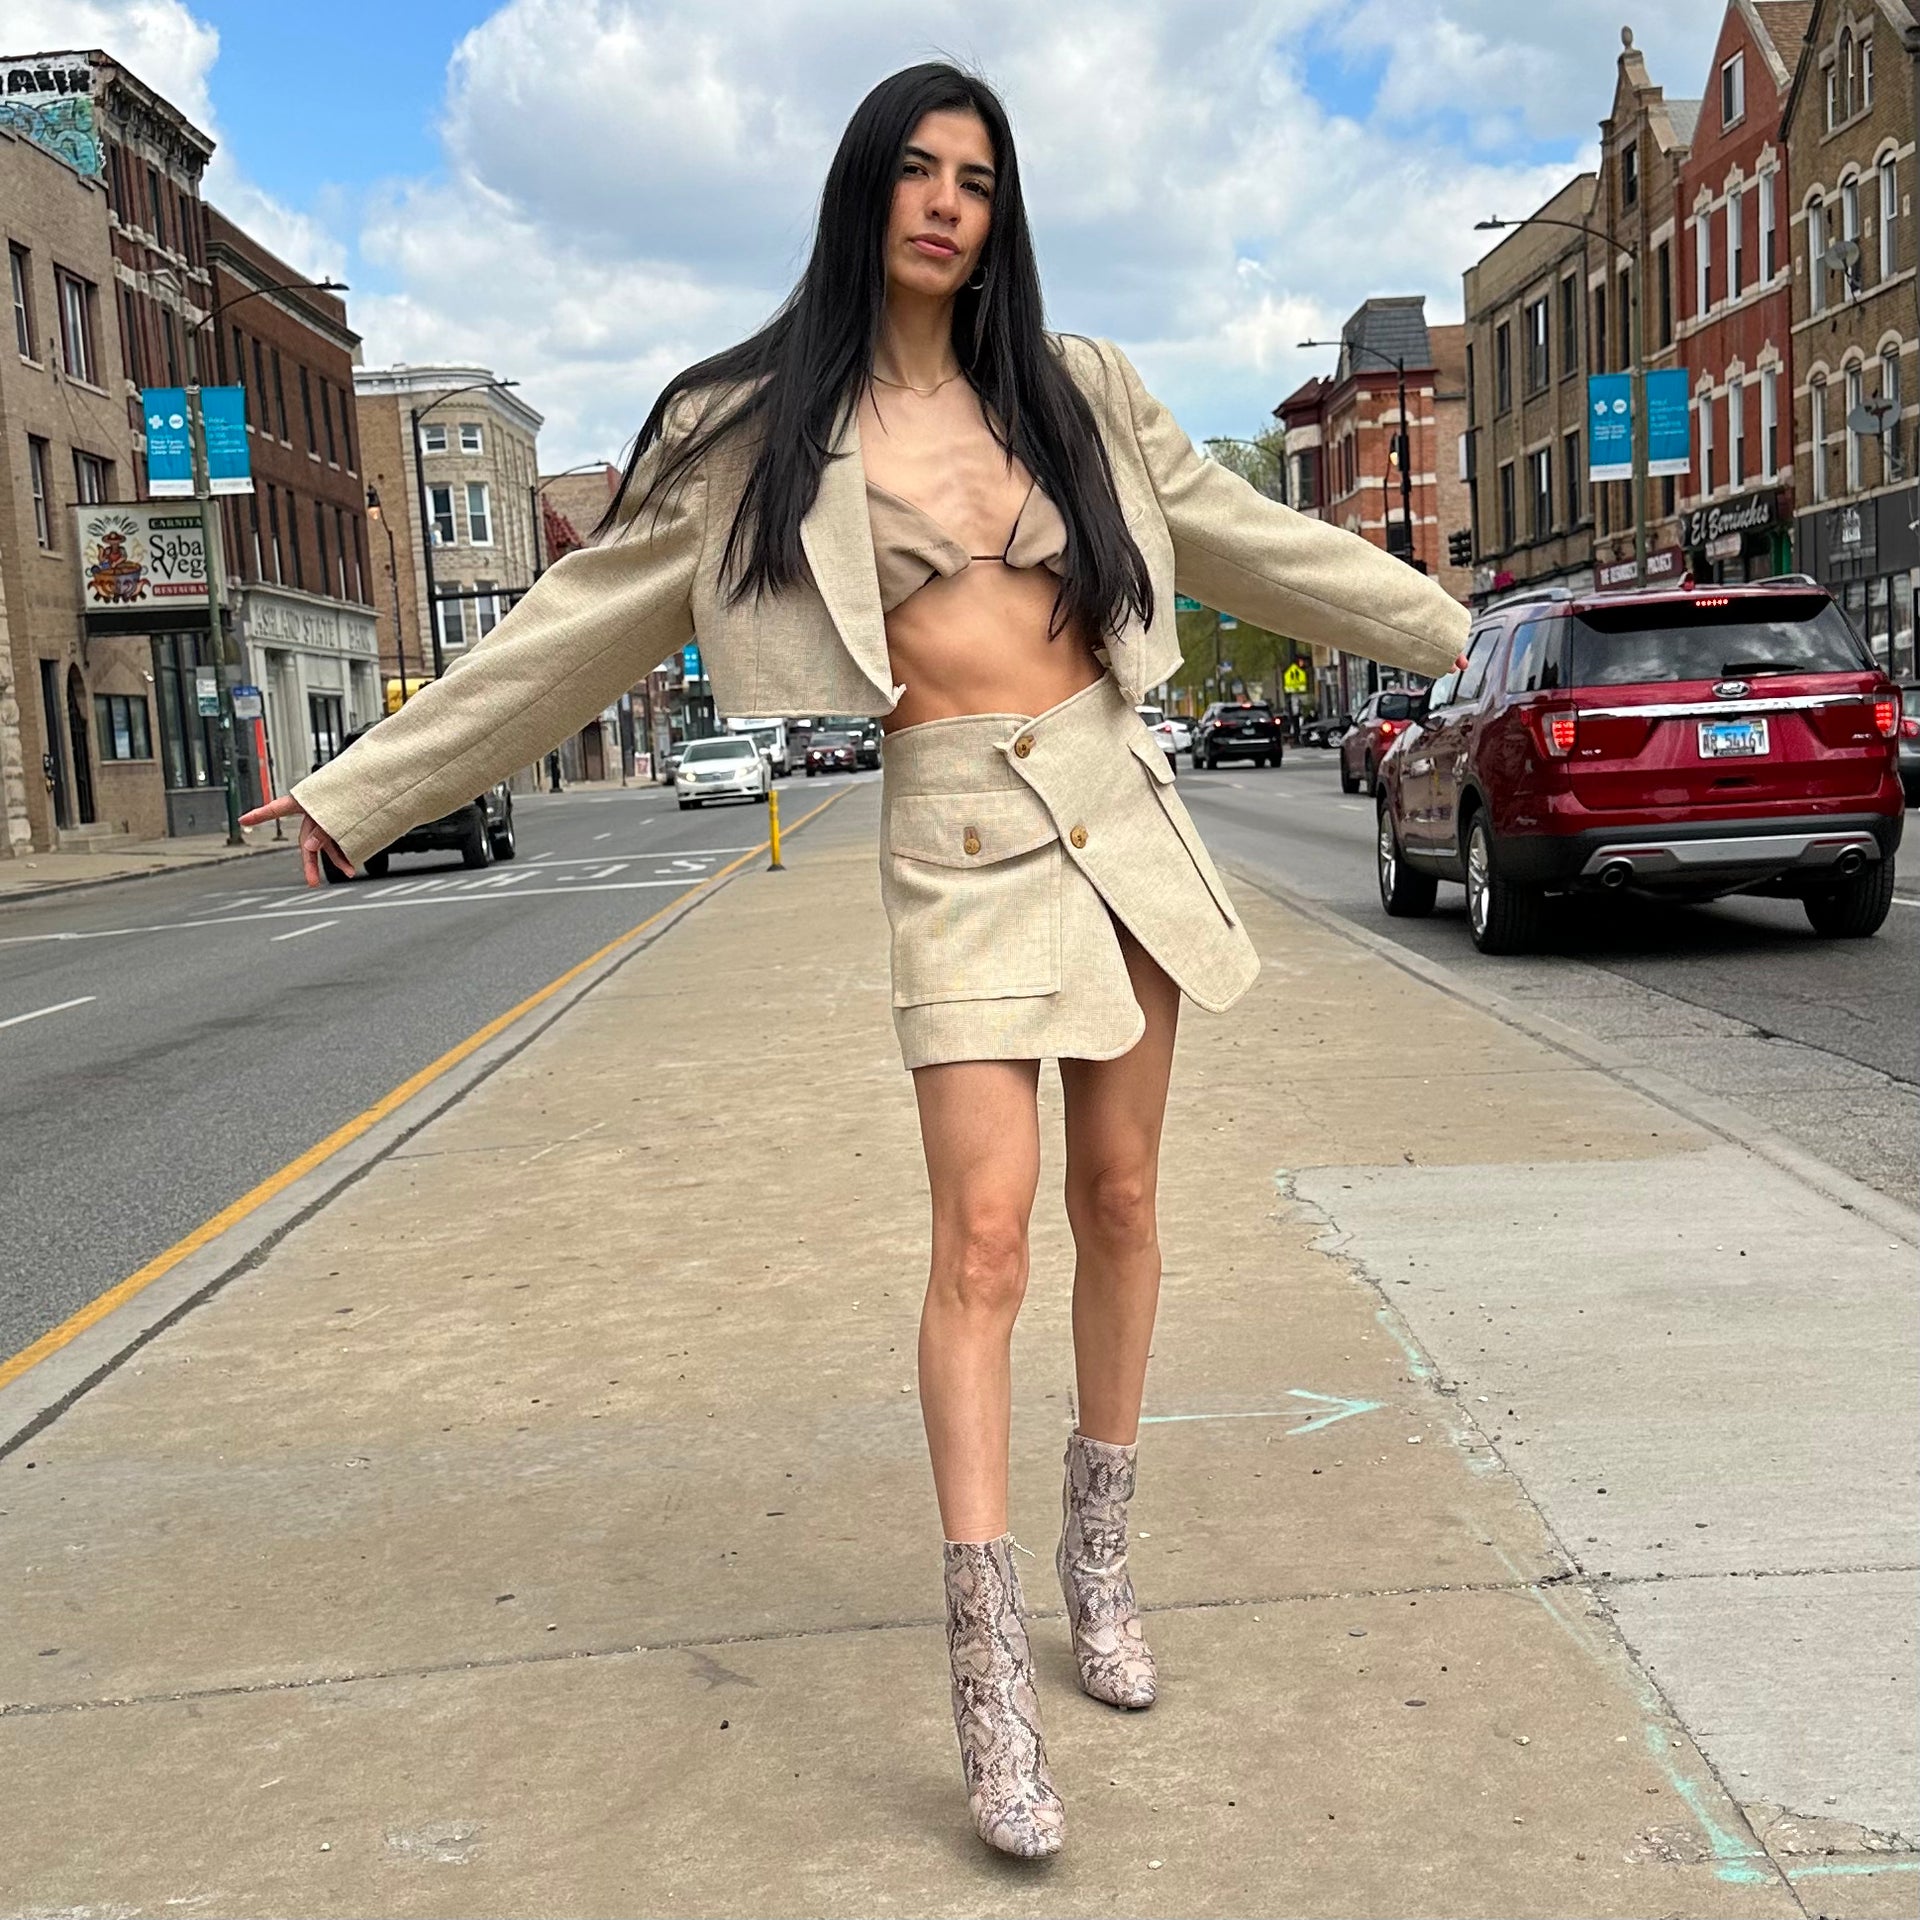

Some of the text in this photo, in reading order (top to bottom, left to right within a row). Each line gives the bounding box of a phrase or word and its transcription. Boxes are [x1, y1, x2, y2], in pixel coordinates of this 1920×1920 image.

[151, 519, 202, 528] CARNITA
[1691, 511, 1706, 545] El
[149, 534, 204, 558] Saba
[151, 557, 207, 580] Veg
[154, 584, 208, 595] RESTAURA
[303, 613, 336, 648] STATE
[347, 618, 371, 653] BANK
